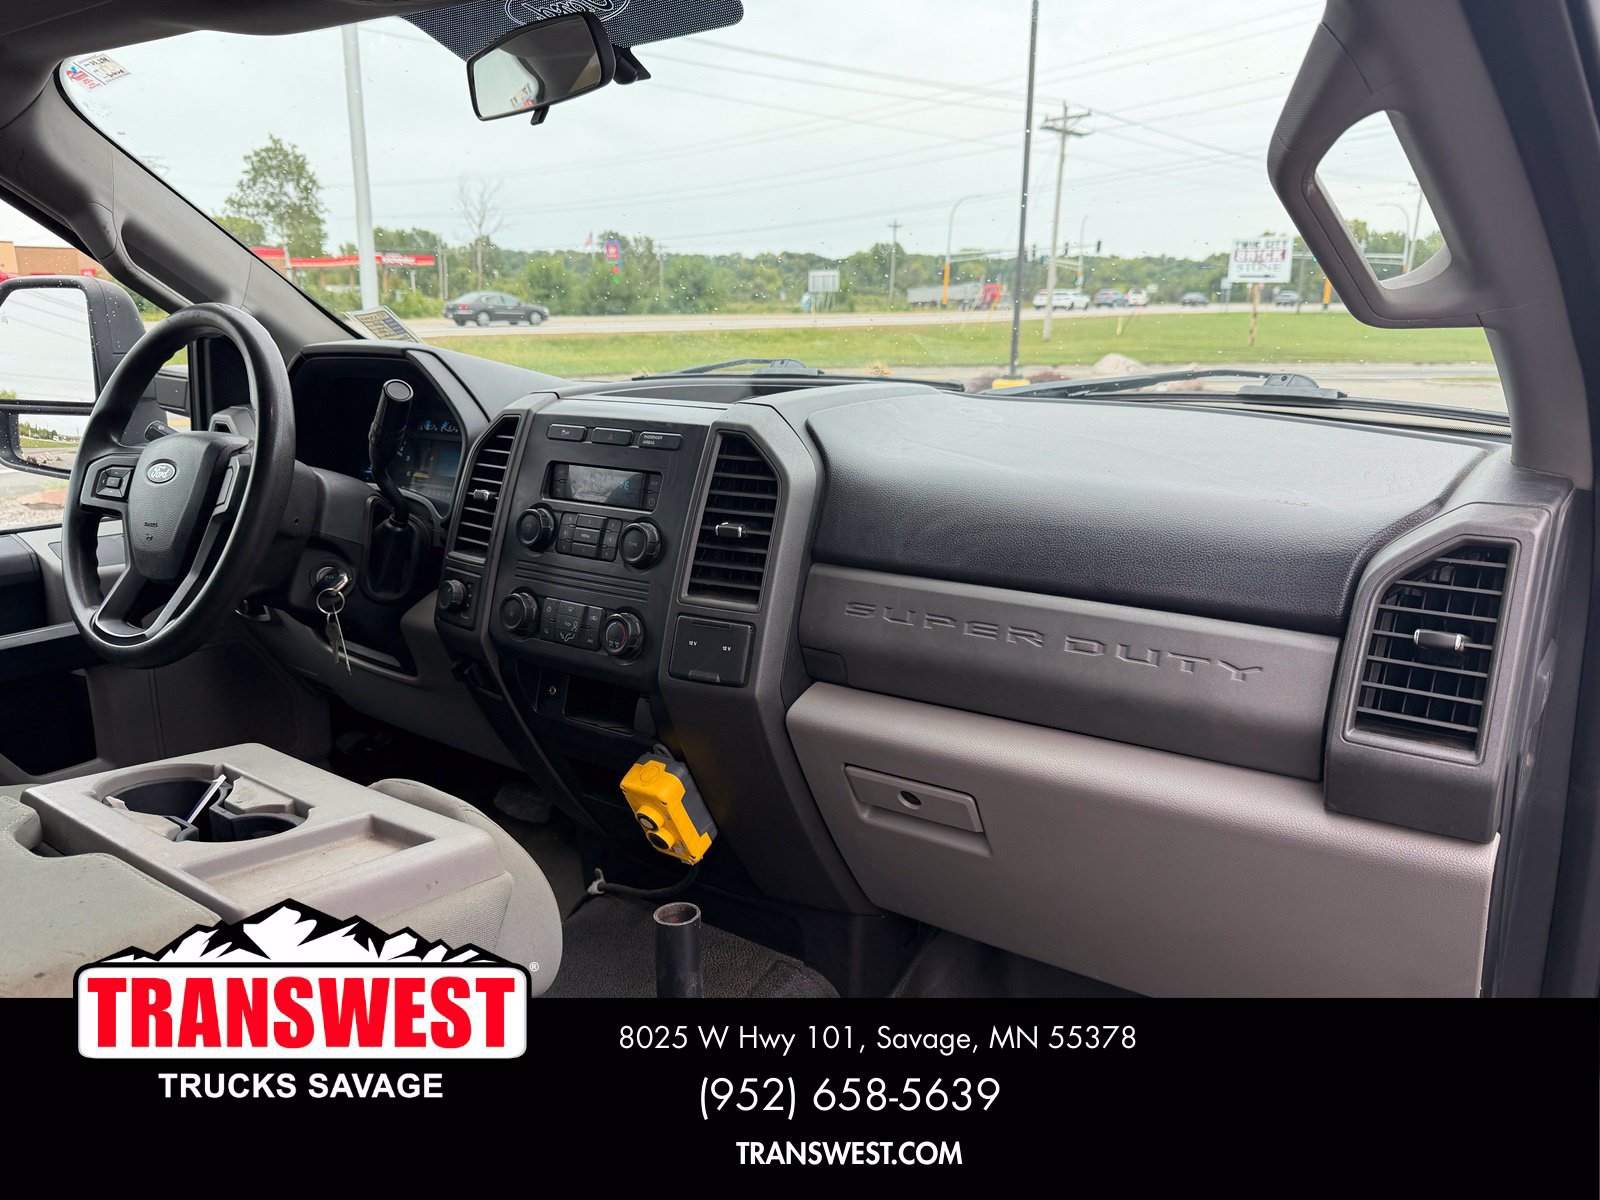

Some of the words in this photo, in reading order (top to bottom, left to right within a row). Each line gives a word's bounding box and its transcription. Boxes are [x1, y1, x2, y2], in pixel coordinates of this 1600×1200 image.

[151, 465, 169, 479] Ford
[845, 601, 1044, 648] SUPER
[1063, 635, 1263, 682] DUTY
